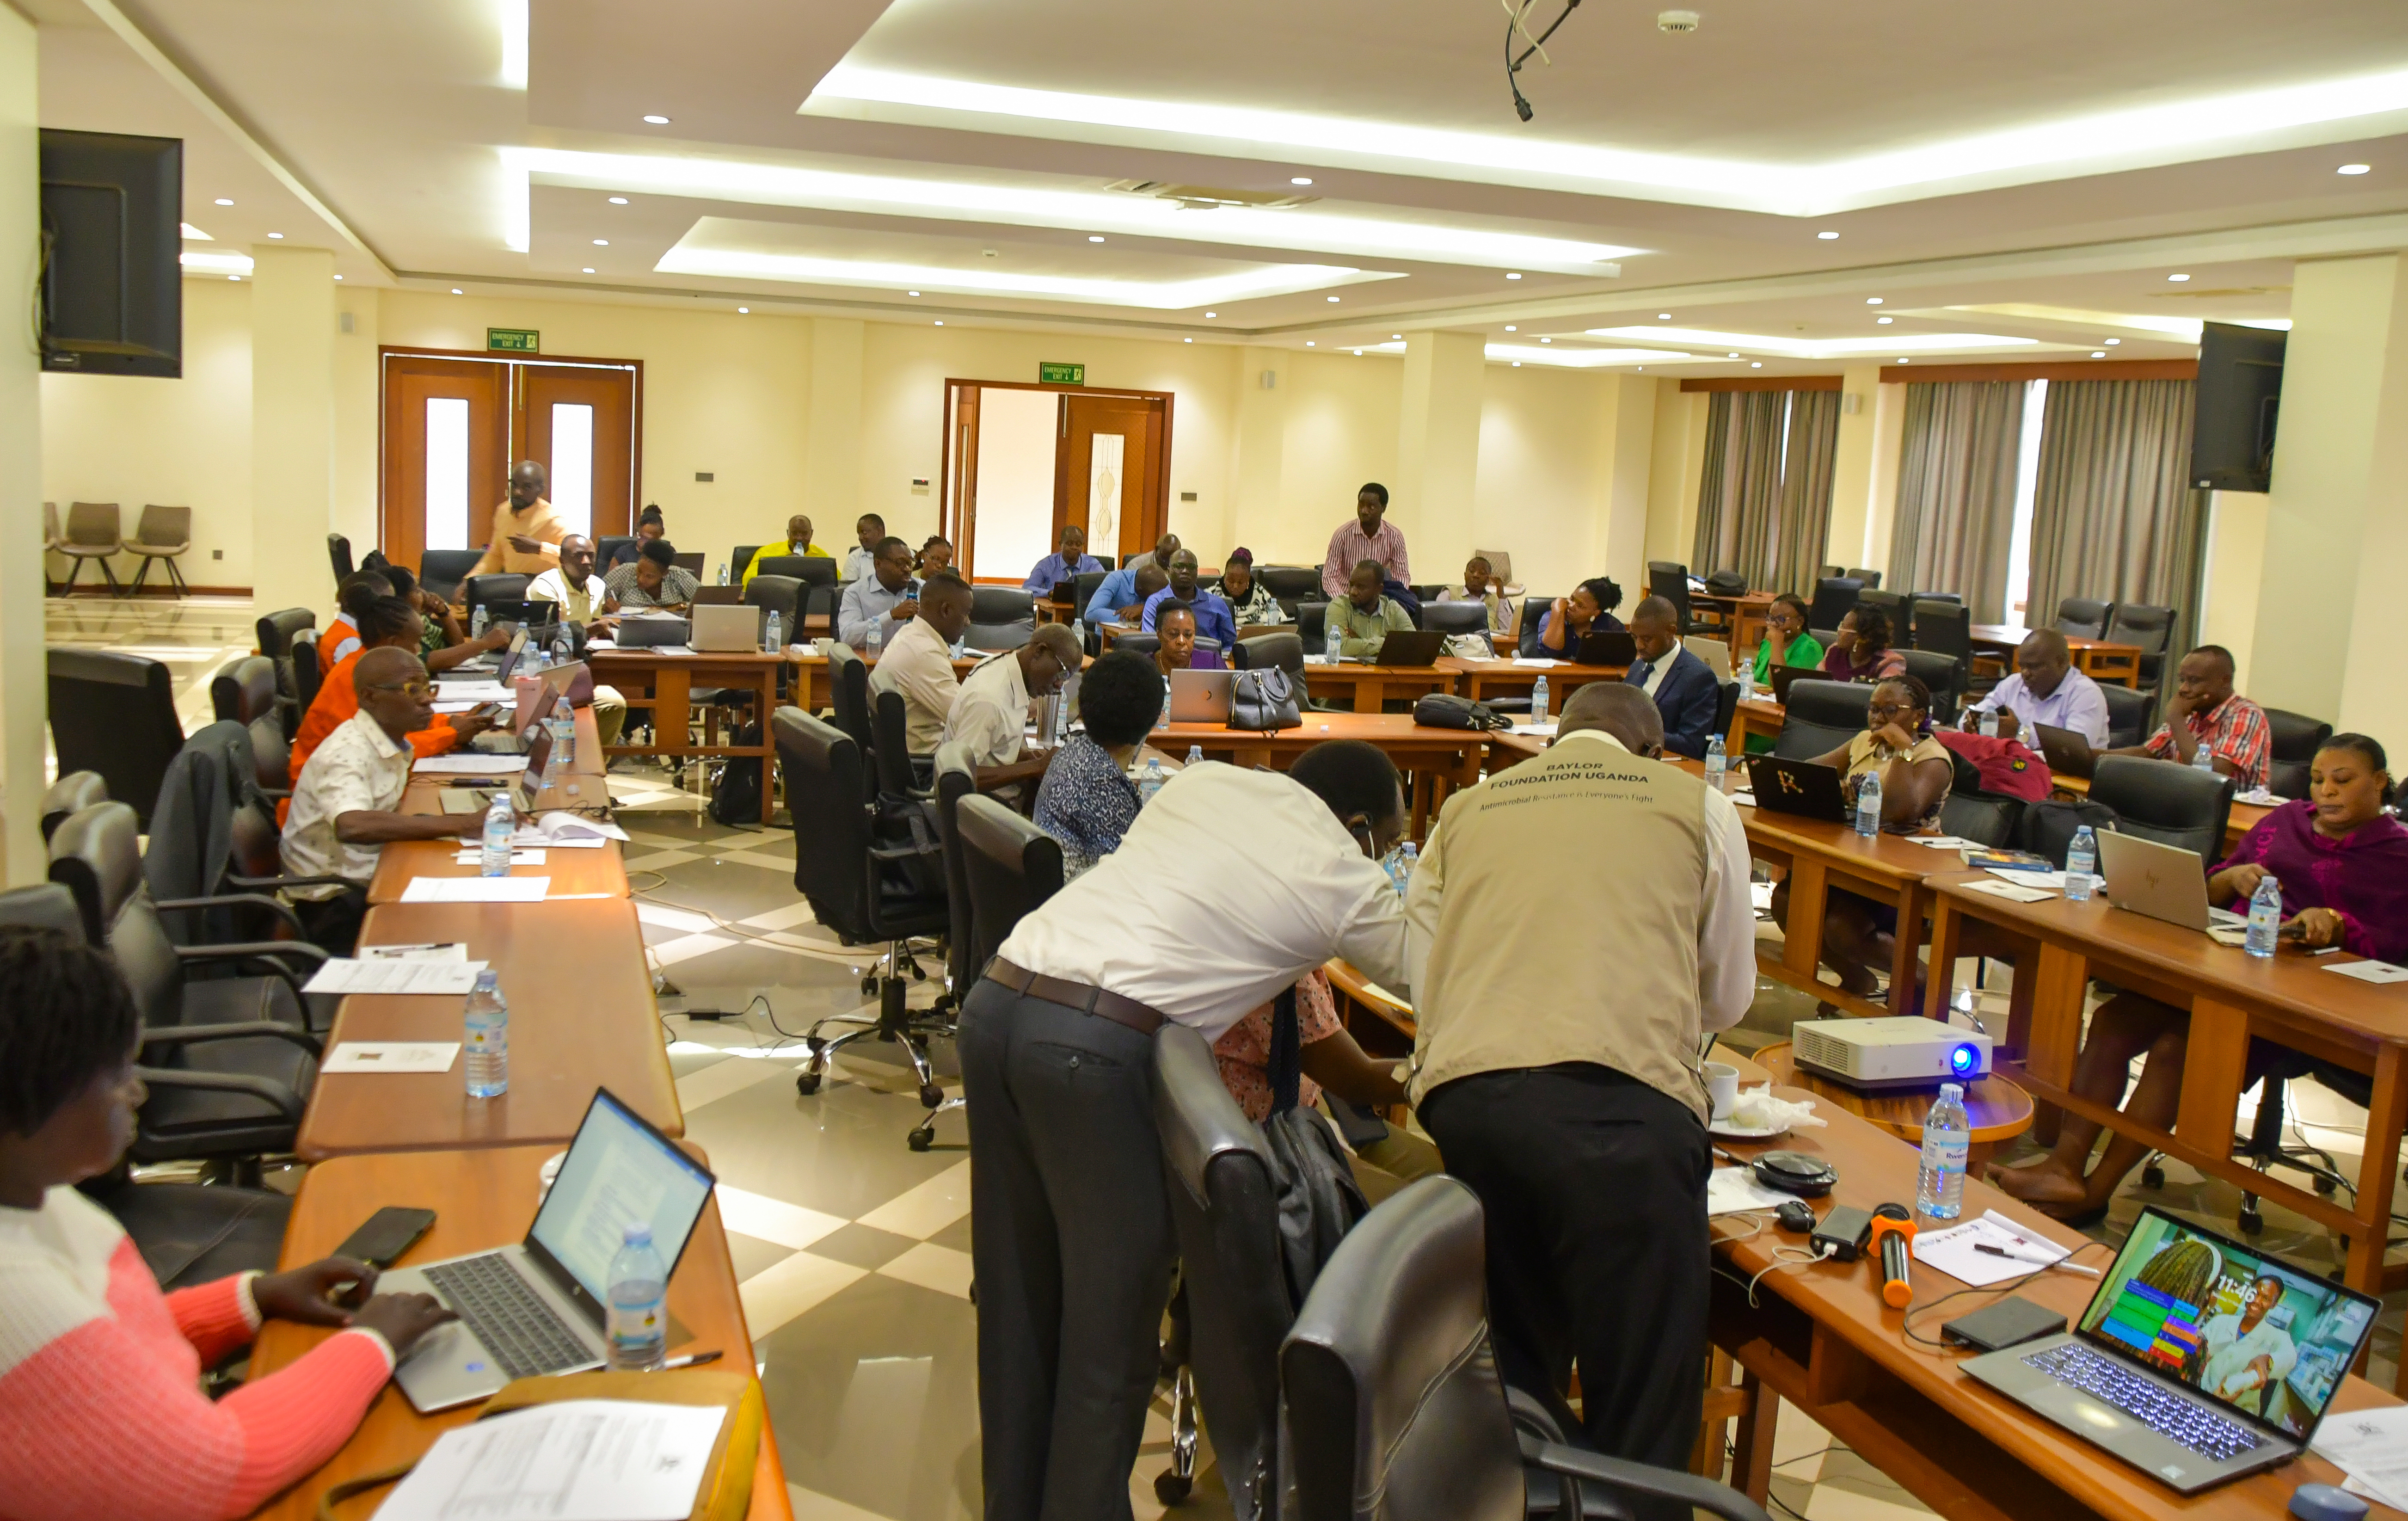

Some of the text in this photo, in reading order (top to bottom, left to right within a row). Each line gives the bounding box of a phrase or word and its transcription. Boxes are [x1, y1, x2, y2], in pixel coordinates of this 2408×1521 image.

[492, 332, 524, 341] EMERGENCY
[1044, 366, 1072, 374] EMERGENCY
[1490, 771, 1649, 789] FOUNDATION UGANDA
[1480, 795, 1531, 812] Antimicrobial
[1532, 793, 1574, 803] Resistance
[1585, 791, 1628, 800] Everyone's
[1632, 794, 1653, 803] Fight
[2218, 1275, 2258, 1303] 11:46
